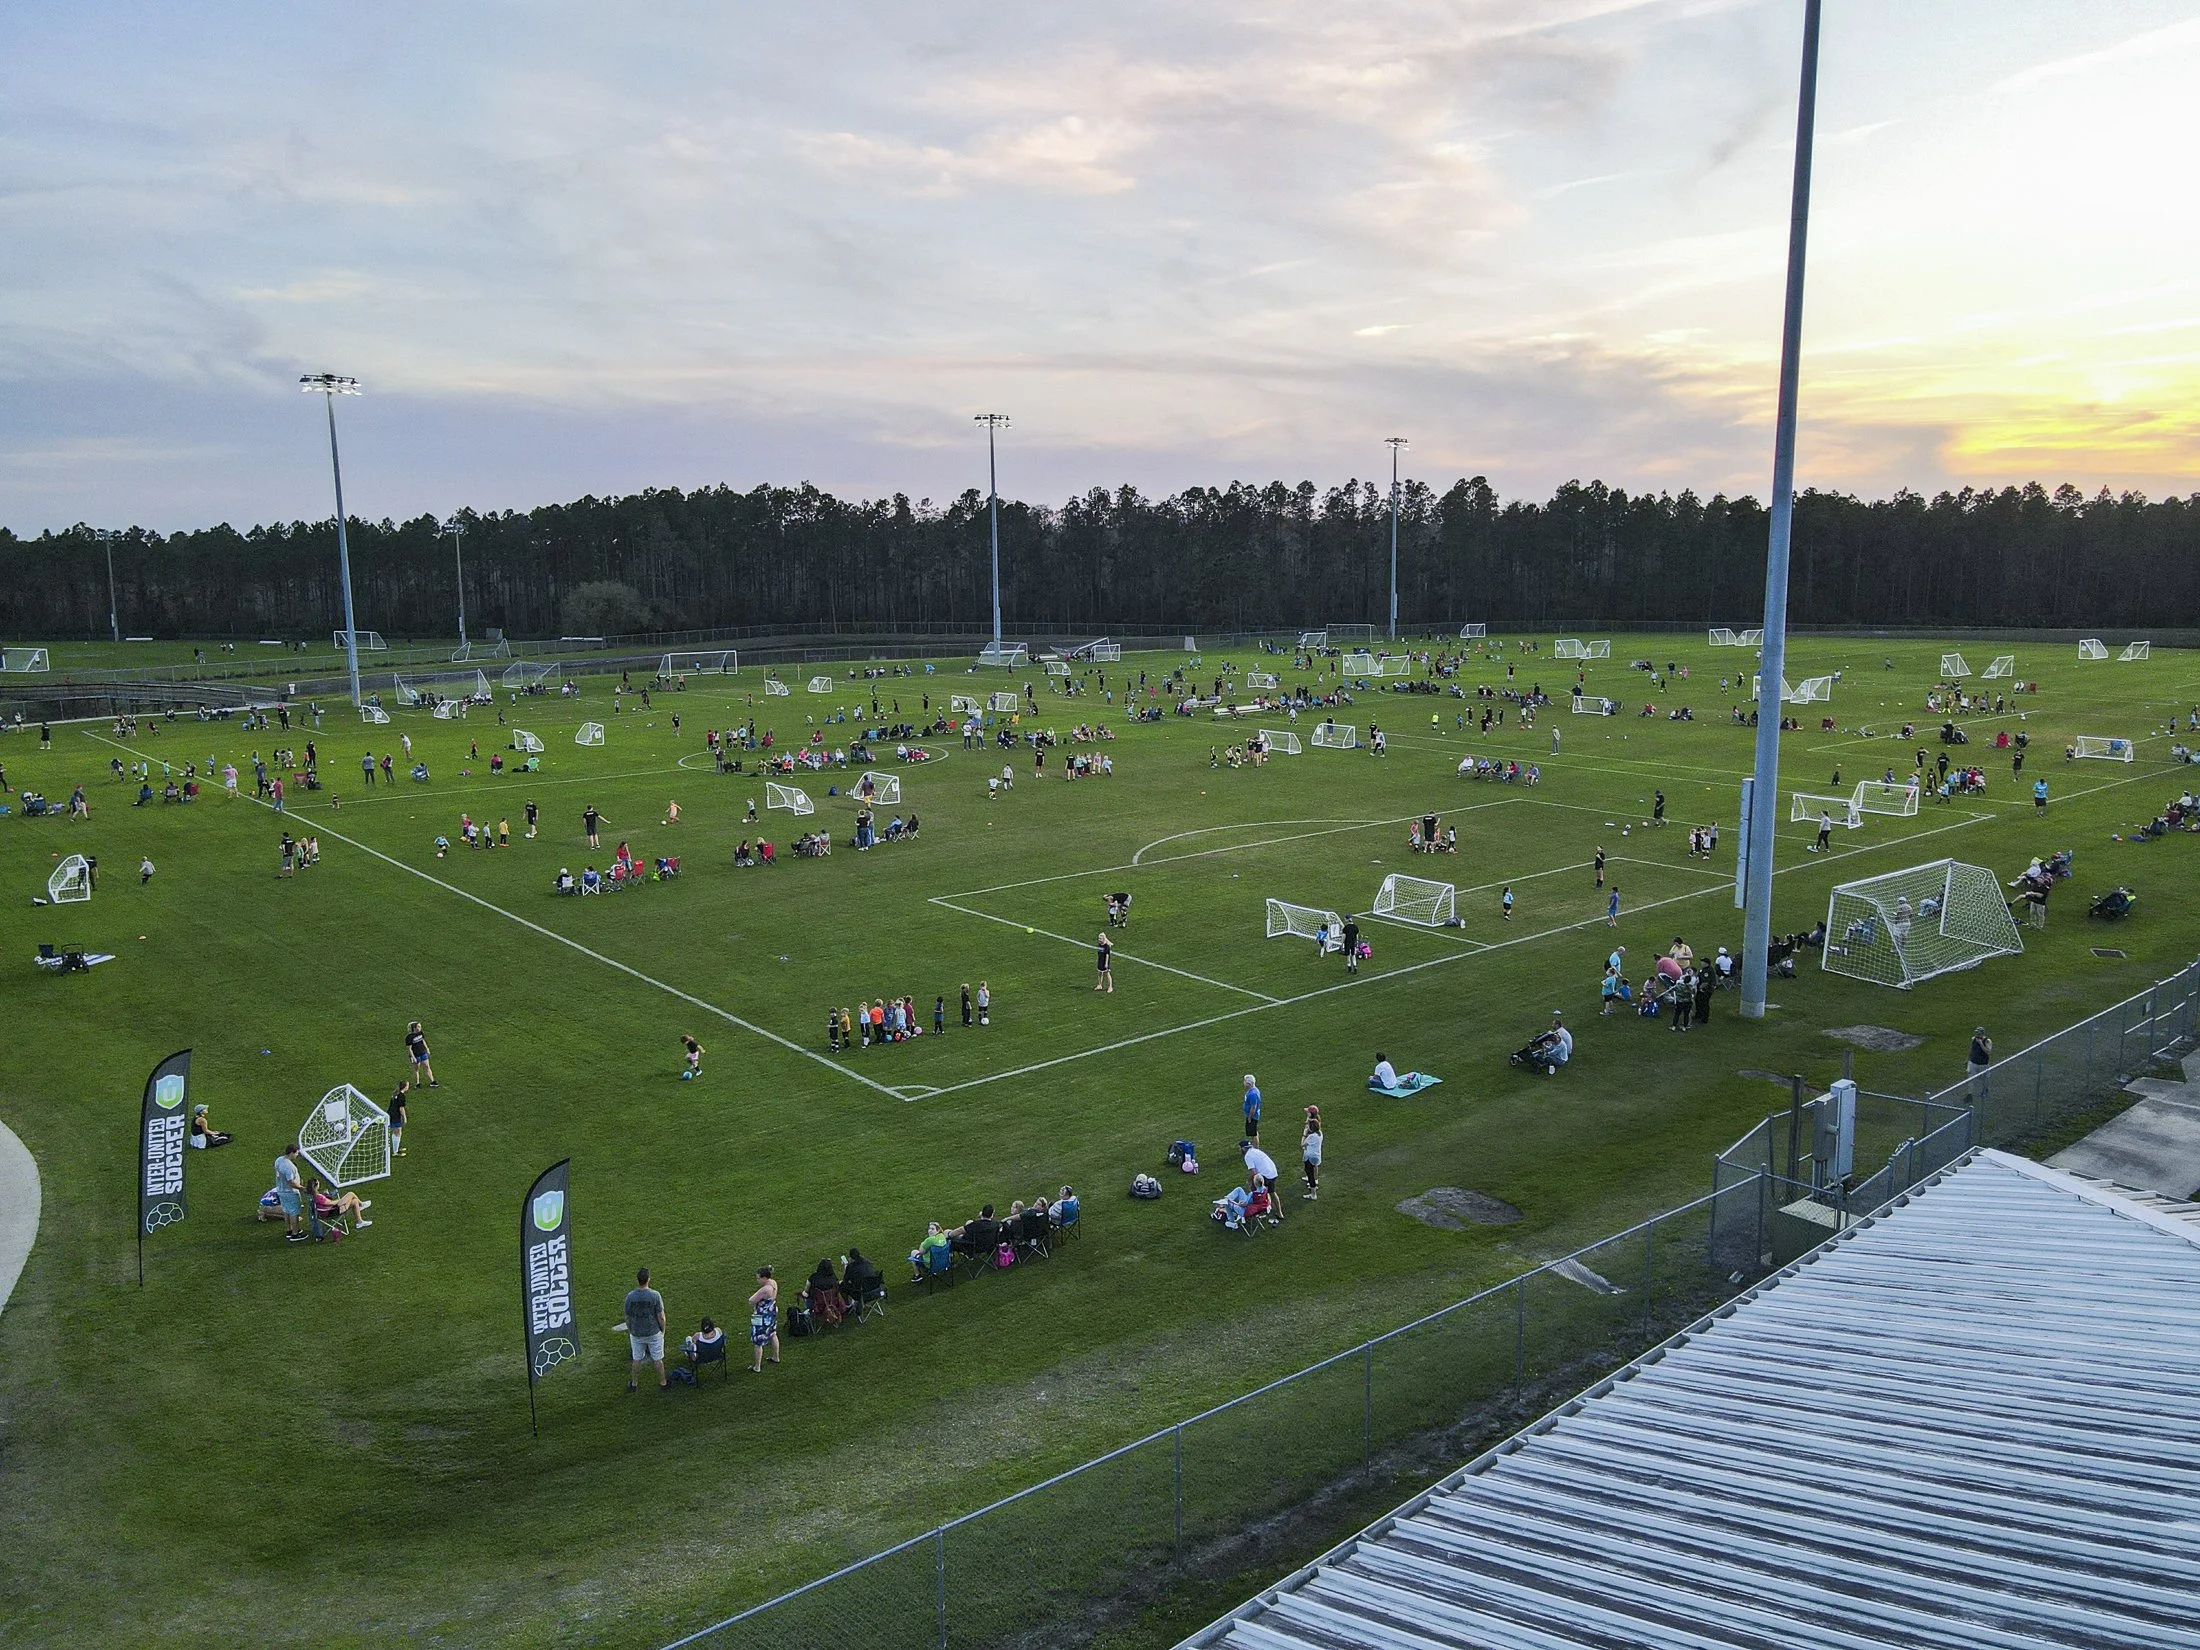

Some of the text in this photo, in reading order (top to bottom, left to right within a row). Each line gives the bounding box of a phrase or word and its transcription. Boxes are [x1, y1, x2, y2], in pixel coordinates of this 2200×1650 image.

[147, 1117, 165, 1196] INTER-UNITED
[165, 1114, 185, 1195] SOCCER
[529, 1242, 549, 1335] INTER-UNITED
[548, 1234, 571, 1329] SOCCER
